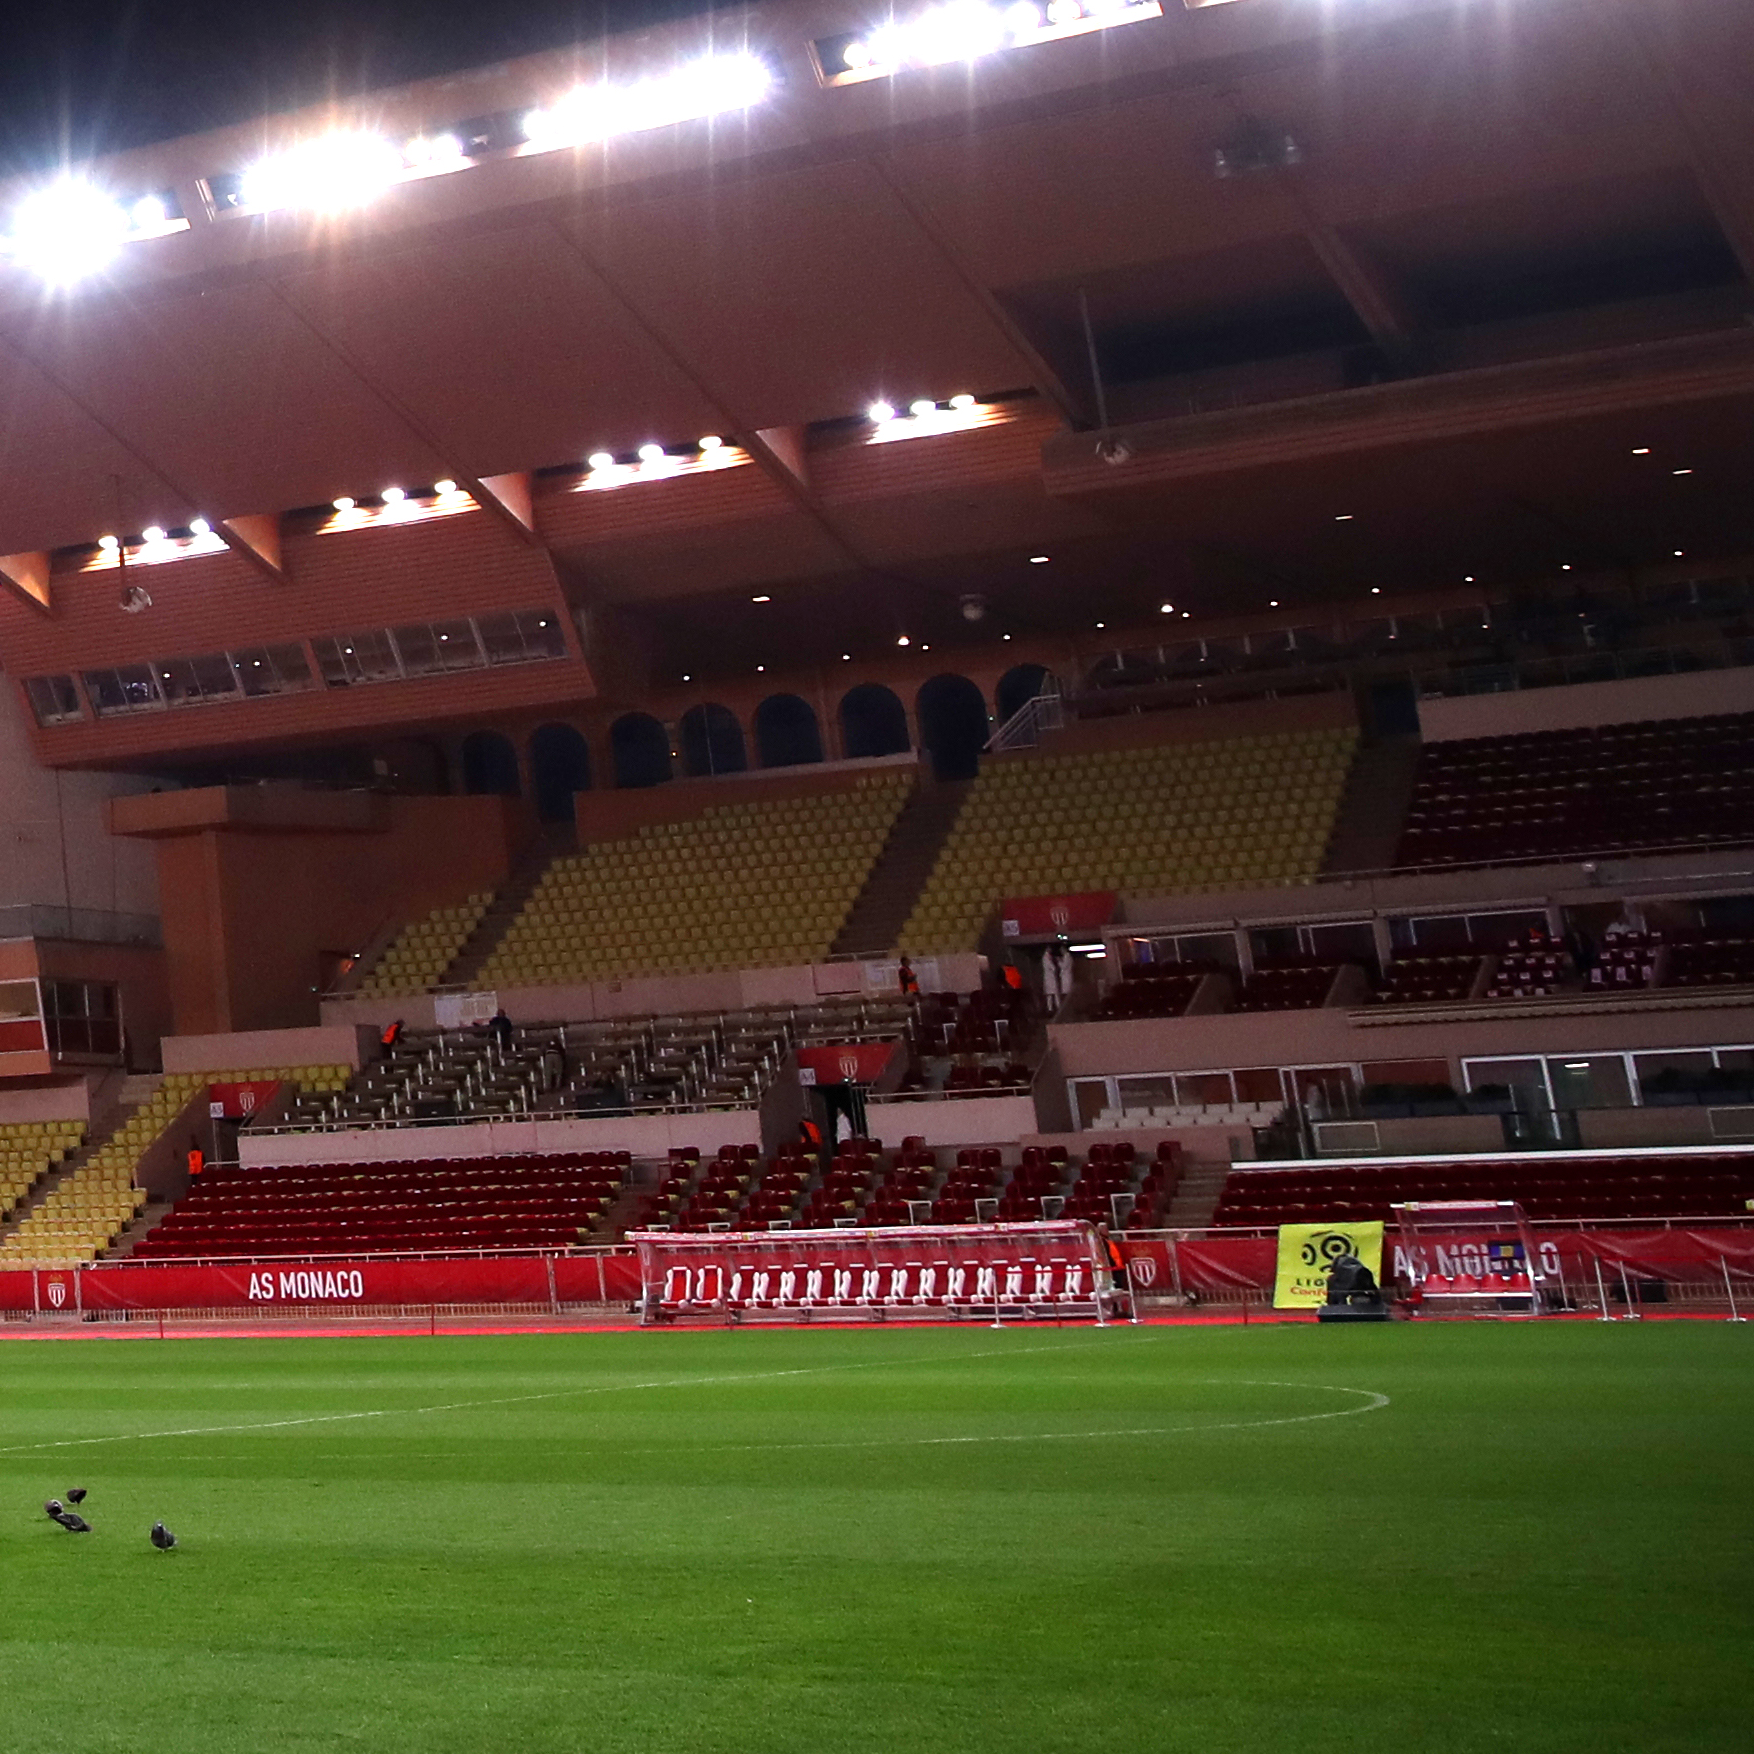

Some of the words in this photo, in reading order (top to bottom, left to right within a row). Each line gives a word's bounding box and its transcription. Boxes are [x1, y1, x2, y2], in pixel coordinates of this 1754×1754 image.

[249, 1271, 275, 1300] AS
[279, 1270, 364, 1299] MONACO
[1295, 1278, 1326, 1287] LIG
